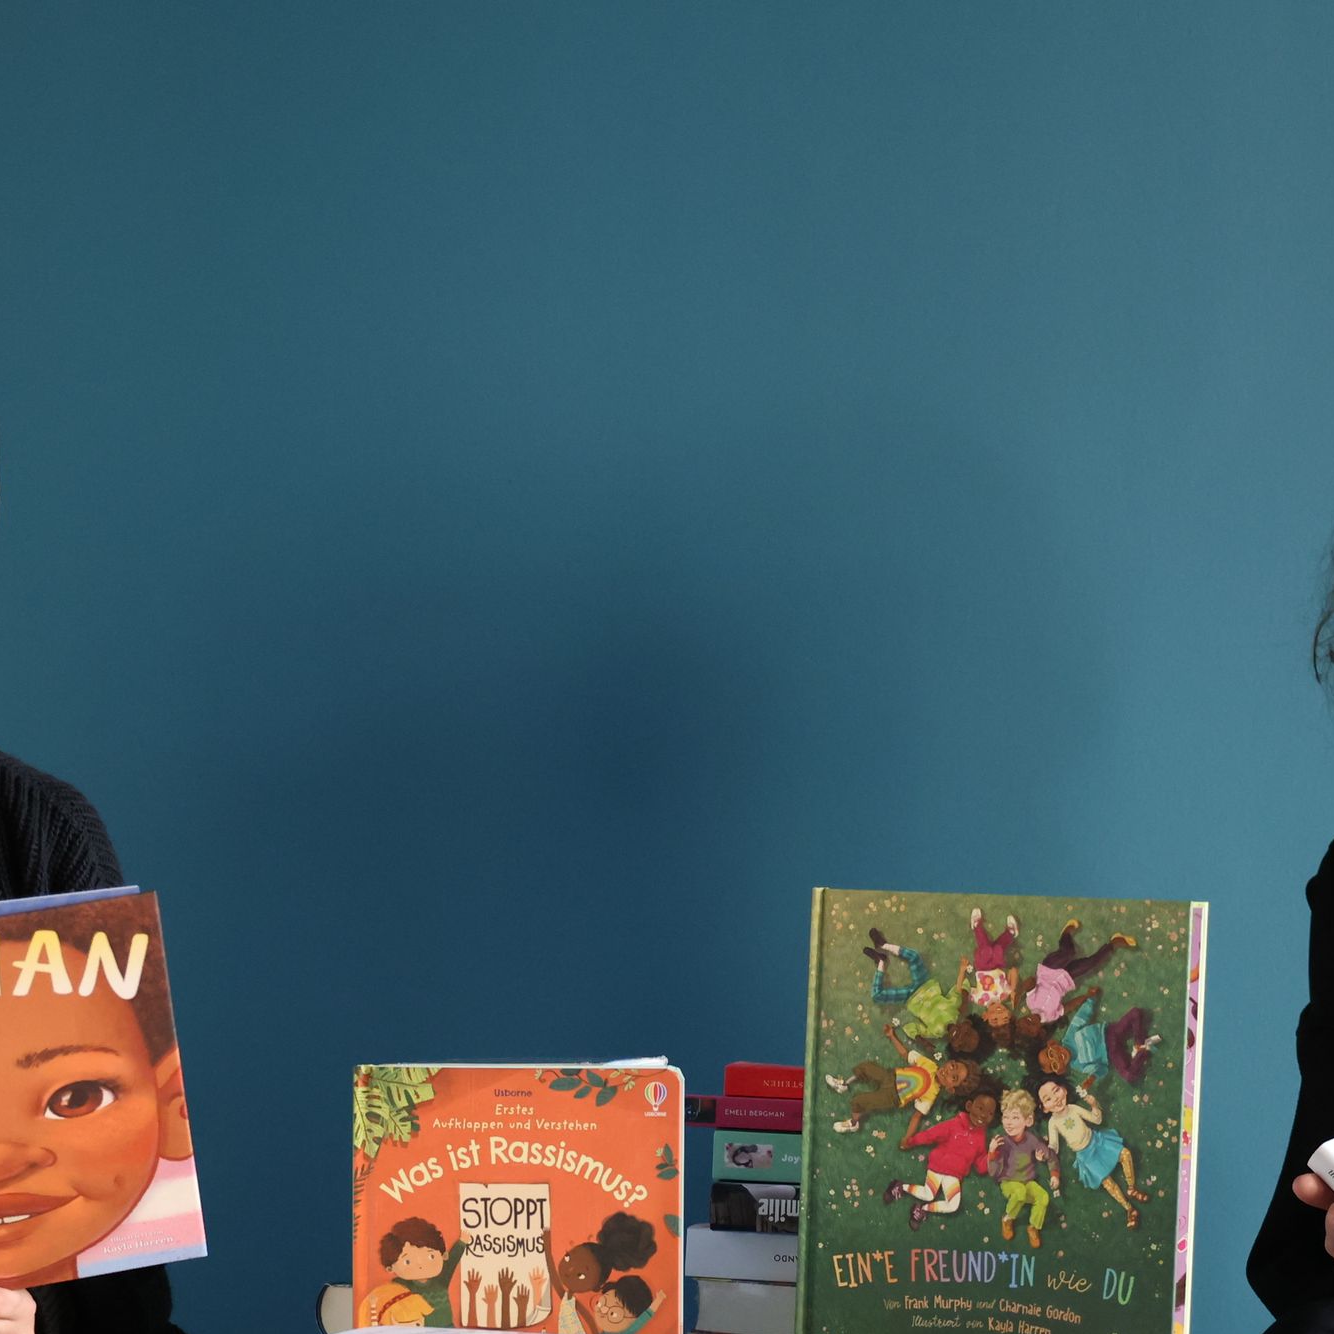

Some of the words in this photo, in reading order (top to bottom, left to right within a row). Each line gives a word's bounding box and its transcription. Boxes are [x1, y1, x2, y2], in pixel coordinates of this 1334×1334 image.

[494, 1089, 533, 1098] Usborne
[495, 1104, 534, 1116] Erstes
[725, 1108, 747, 1116] EMELI
[749, 1110, 785, 1118] BERGMAN
[433, 1118, 503, 1132] Aufklappen
[510, 1119, 531, 1131] und
[536, 1119, 598, 1131] Verstehen
[782, 1154, 801, 1165] Joy
[379, 1157, 444, 1204] Was
[446, 1139, 482, 1172] ist
[490, 1136, 649, 1208] Rassismus?
[462, 1197, 547, 1230] STOPPT
[757, 1198, 800, 1223] milie
[466, 1233, 545, 1258] RASSISMUS
[1047, 1269, 1093, 1293] wie
[1104, 1268, 1136, 1307] DU
[883, 1298, 902, 1311] Von
[905, 1296, 929, 1310] Frank
[934, 1296, 972, 1312] Murphy
[976, 1300, 996, 1310] und
[1000, 1299, 1042, 1318] Charnaie
[1047, 1305, 1082, 1325] Gordon
[912, 1313, 961, 1329] Illustriert
[966, 1318, 984, 1330] von
[988, 1317, 1014, 1334] Kayla
